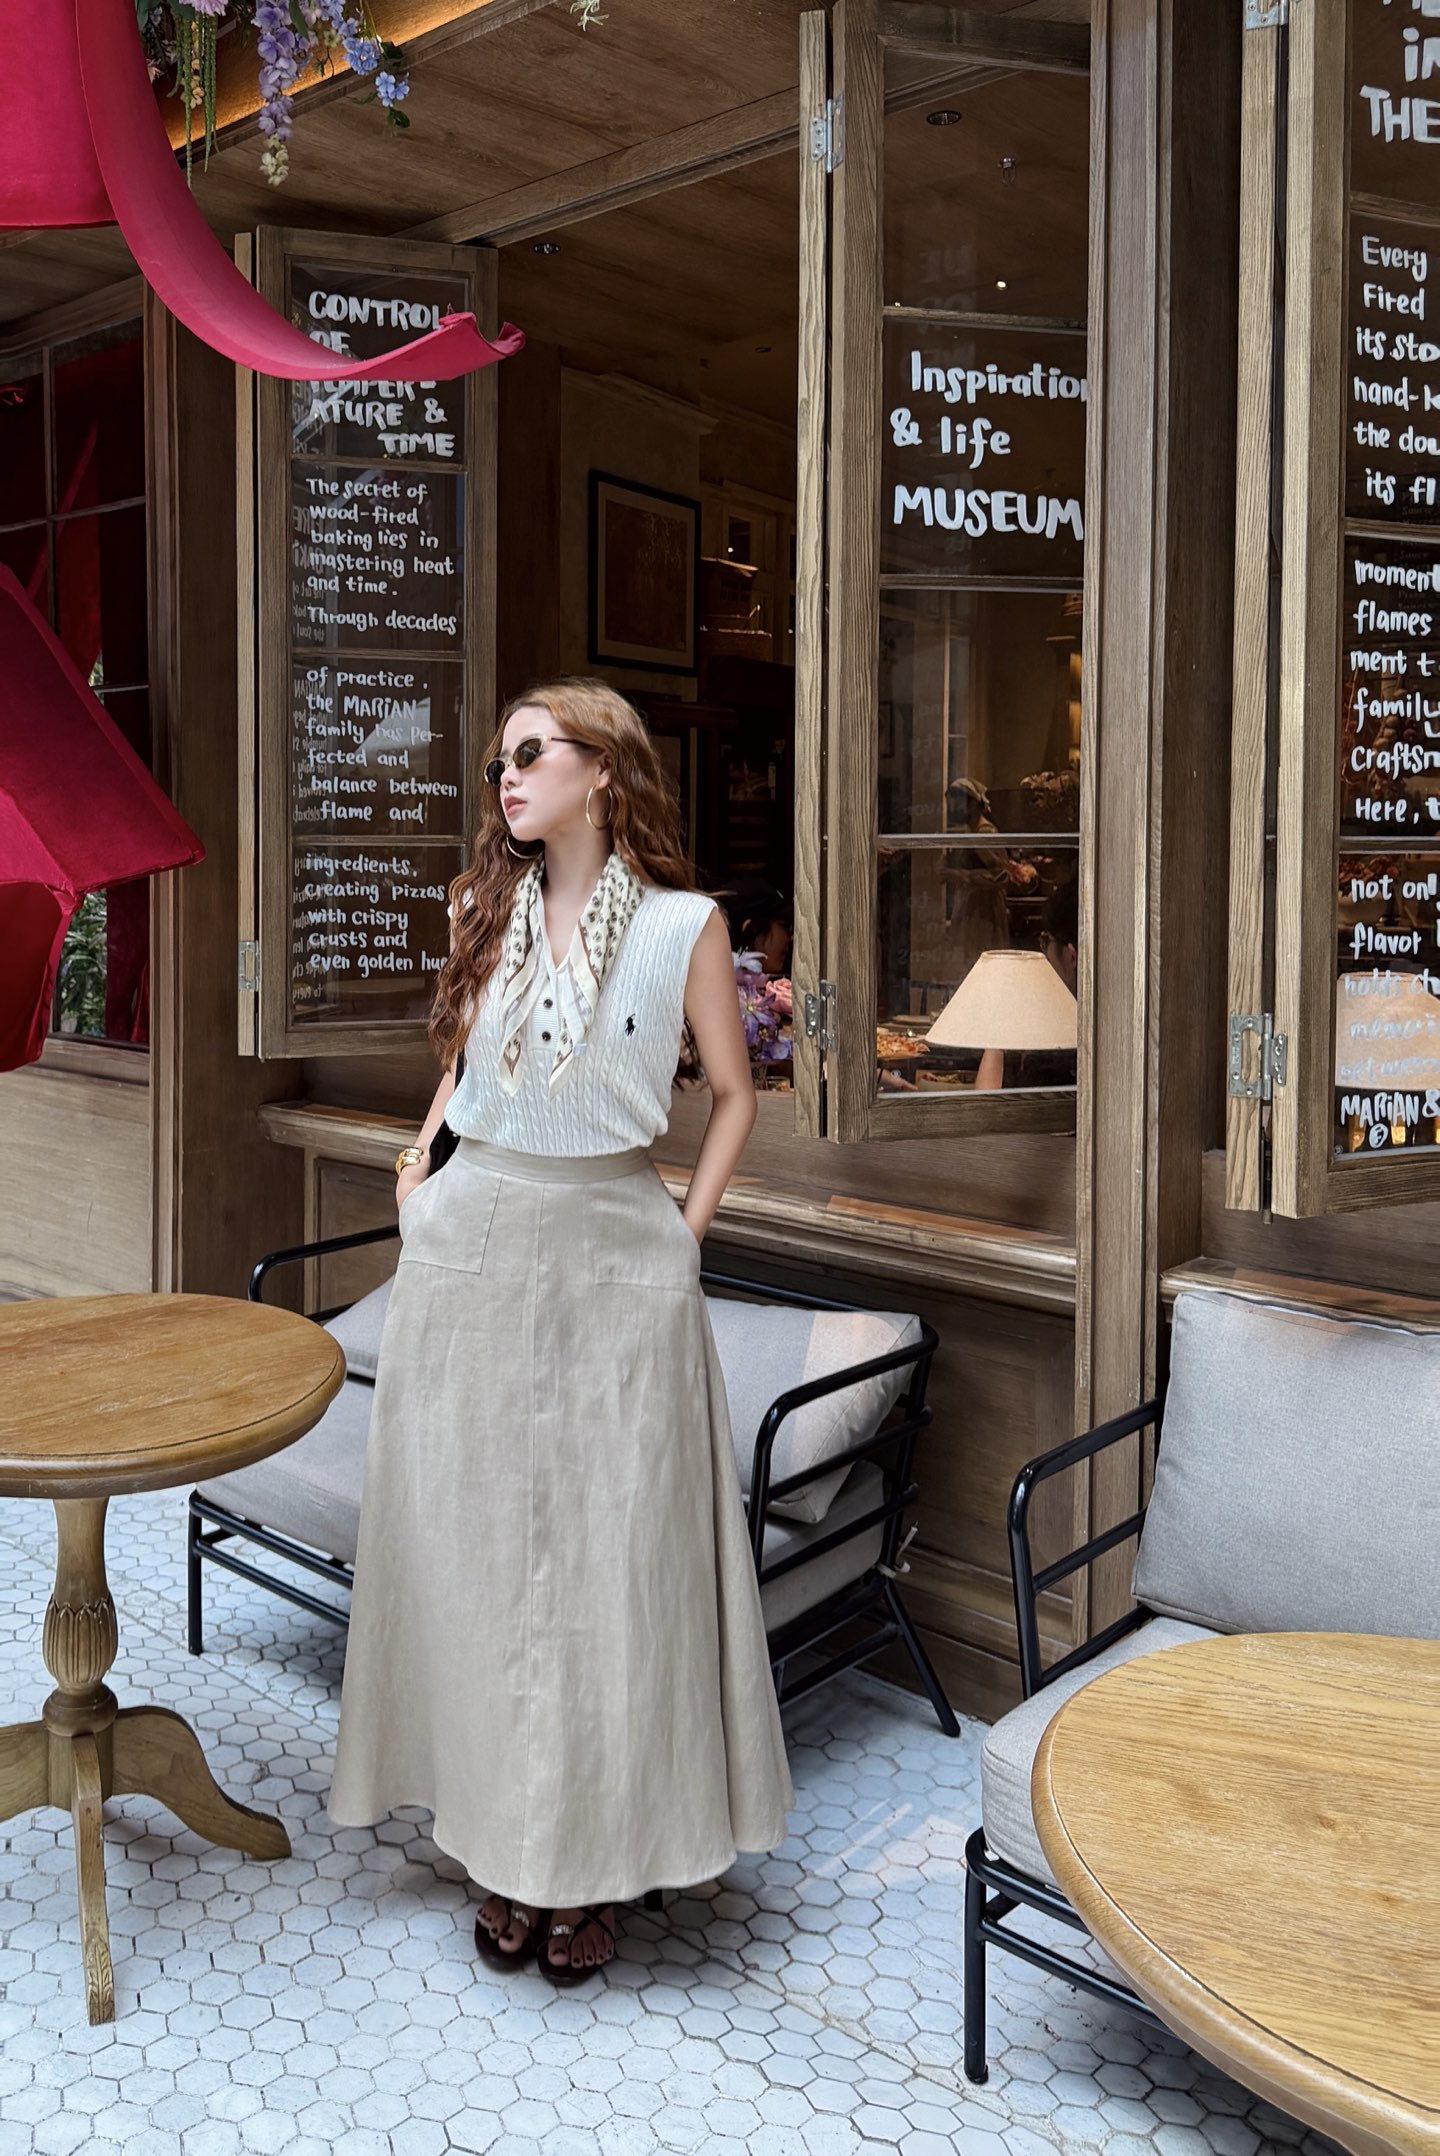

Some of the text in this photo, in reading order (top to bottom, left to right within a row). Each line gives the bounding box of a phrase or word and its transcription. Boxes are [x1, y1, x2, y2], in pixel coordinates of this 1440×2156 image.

[1362, 235, 1428, 282] Every
[1363, 282, 1425, 321] Fired
[1355, 326, 1387, 361] its
[309, 398, 404, 431] ATURE
[423, 397, 448, 424] &
[890, 407, 1011, 469] & life
[1352, 421, 1390, 449] the
[306, 478, 339, 496] The
[406, 483, 428, 505] of
[1365, 467, 1396, 506] its
[893, 484, 1084, 541] MUSEUM
[311, 529, 439, 552] baking lies in
[308, 552, 455, 578] mastering heat
[307, 575, 340, 593] and
[307, 606, 457, 635] Through decades
[1352, 599, 1433, 637] flames
[306, 666, 329, 688] of
[306, 692, 334, 713] the
[305, 716, 365, 744] family
[308, 747, 367, 768] fected
[377, 749, 409, 769] and
[311, 774, 378, 794] balance
[389, 777, 458, 798] between
[320, 799, 373, 821] flame
[389, 801, 423, 824] and
[391, 882, 446, 901] pizzas
[1351, 874, 1393, 903] not
[307, 907, 347, 925] with
[351, 908, 408, 931] crispy
[308, 930, 407, 949] crusts and
[1349, 921, 1422, 960] flavor
[309, 953, 350, 971] even
[357, 951, 413, 978] golden
